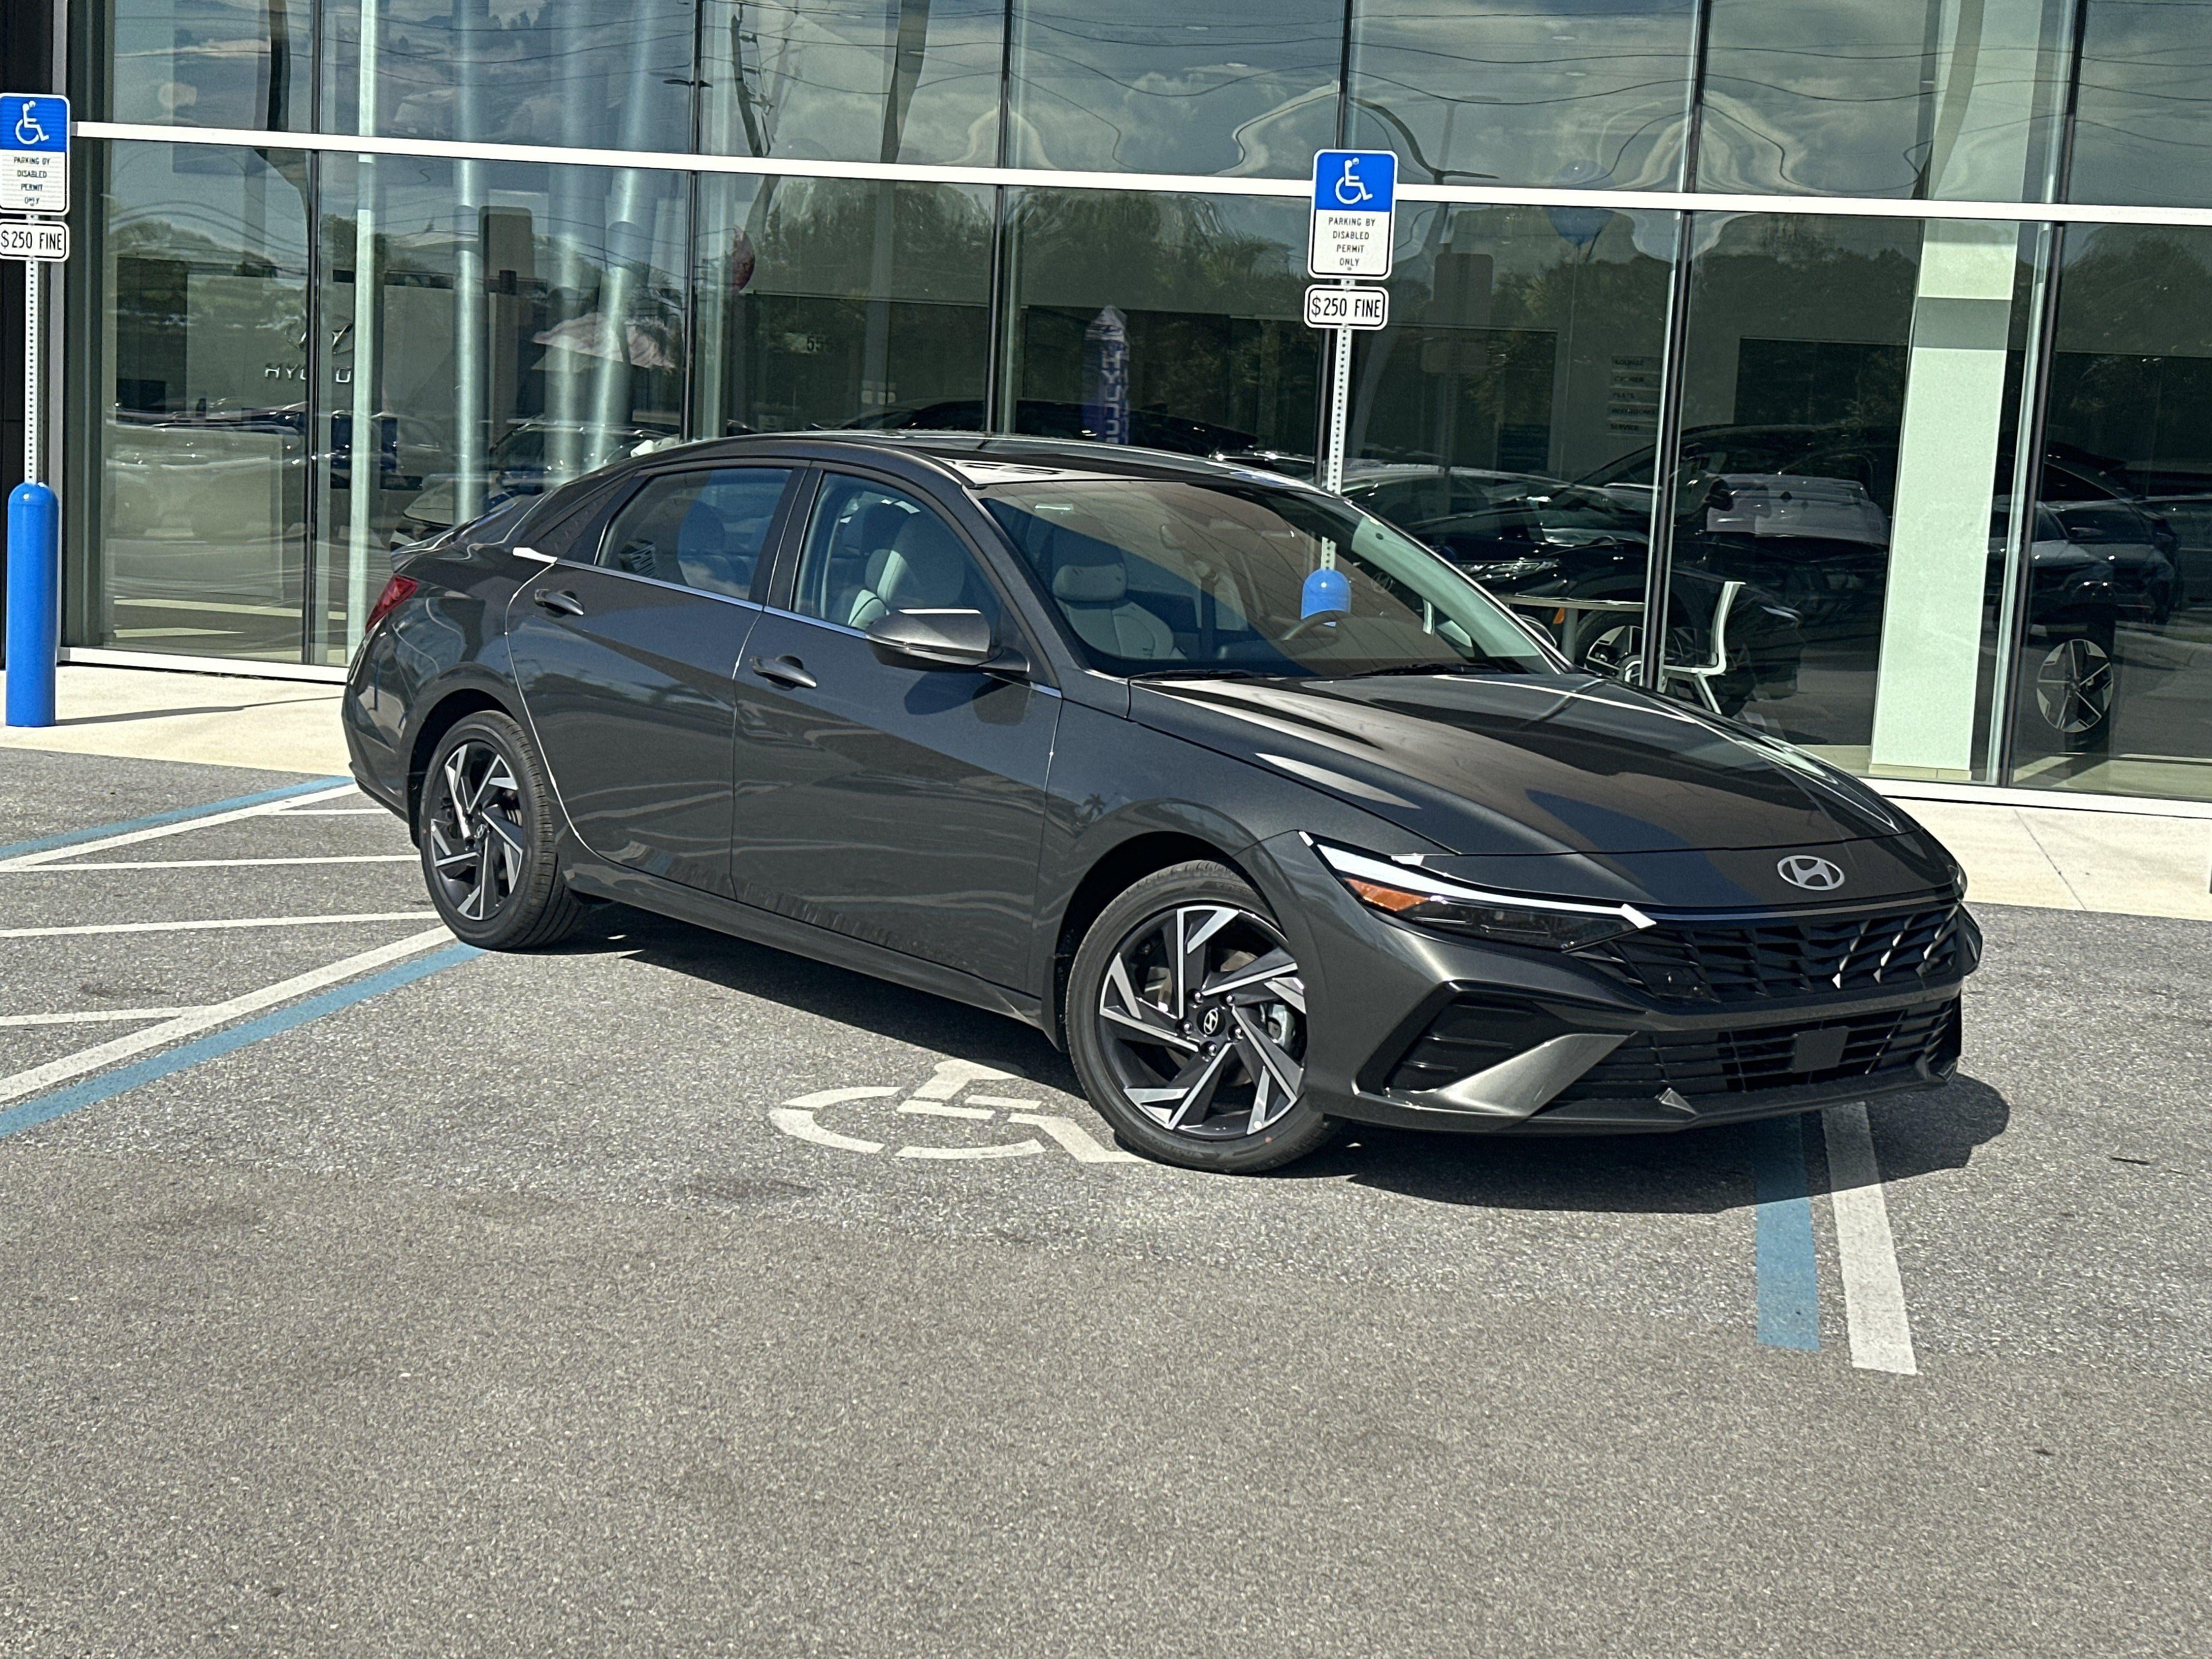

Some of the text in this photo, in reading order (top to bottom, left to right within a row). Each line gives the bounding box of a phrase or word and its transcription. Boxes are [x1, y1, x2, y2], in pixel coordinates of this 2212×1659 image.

[14, 157, 40, 165] PARKING
[17, 170, 47, 178] DISABLED
[21, 183, 43, 191] PERMIT
[1329, 217, 1375, 227] PARKING BY
[1, 229, 63, 250] $250 FINE
[1333, 231, 1369, 240] DISABLED
[1336, 244, 1364, 253] PERMIT
[1340, 258, 1359, 266] ONLY
[1311, 295, 1381, 318] $250 FINE
